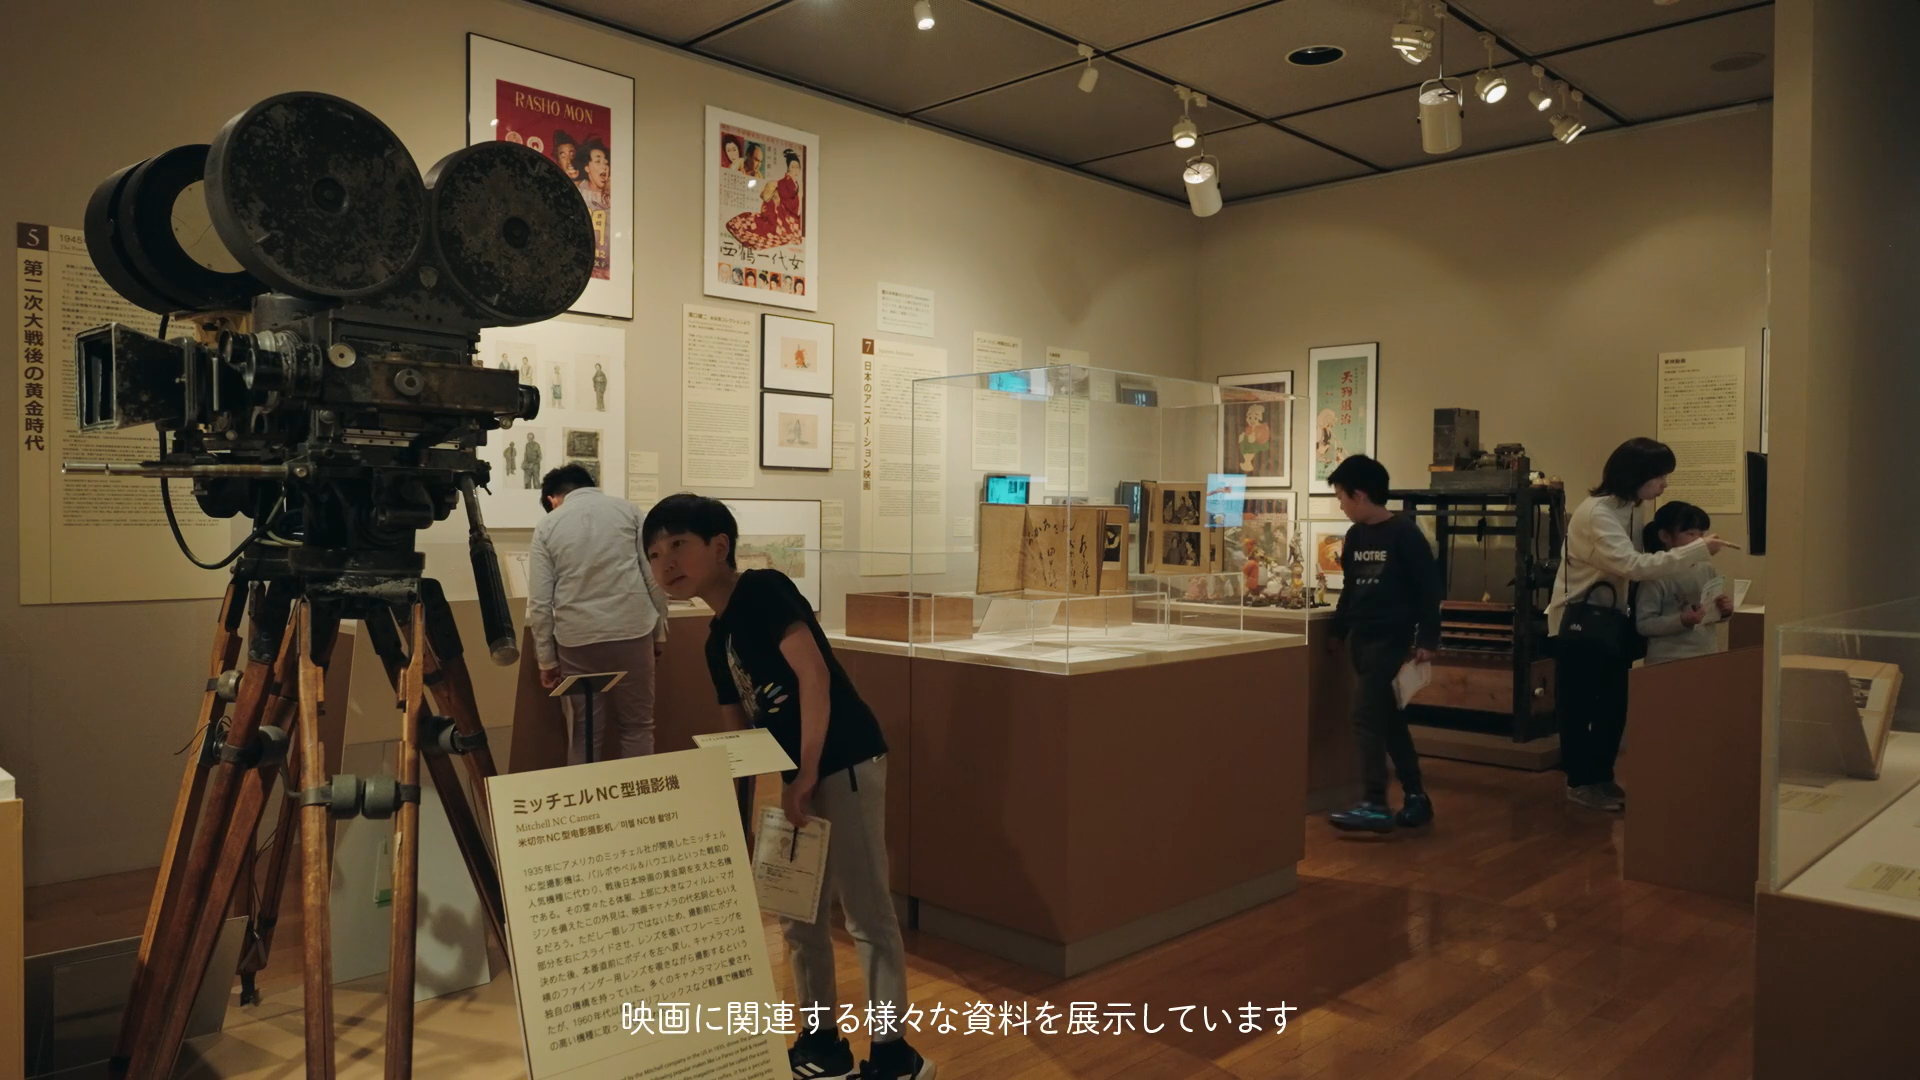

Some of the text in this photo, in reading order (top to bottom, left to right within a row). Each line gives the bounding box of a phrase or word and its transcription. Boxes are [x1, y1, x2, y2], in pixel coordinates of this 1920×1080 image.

[515, 91, 593, 125] RASHO MON
[26, 228, 40, 246] 5
[60, 234, 86, 246] 1945
[720, 241, 804, 271] 西鶴一代女
[22, 259, 45, 452] 第二次大戦後の黄金時代
[865, 342, 872, 352] 7
[863, 361, 872, 491] 日本のアニメーション映画
[1354, 550, 1387, 561] NOTRE
[516, 812, 601, 833] Mitchell NC Camera
